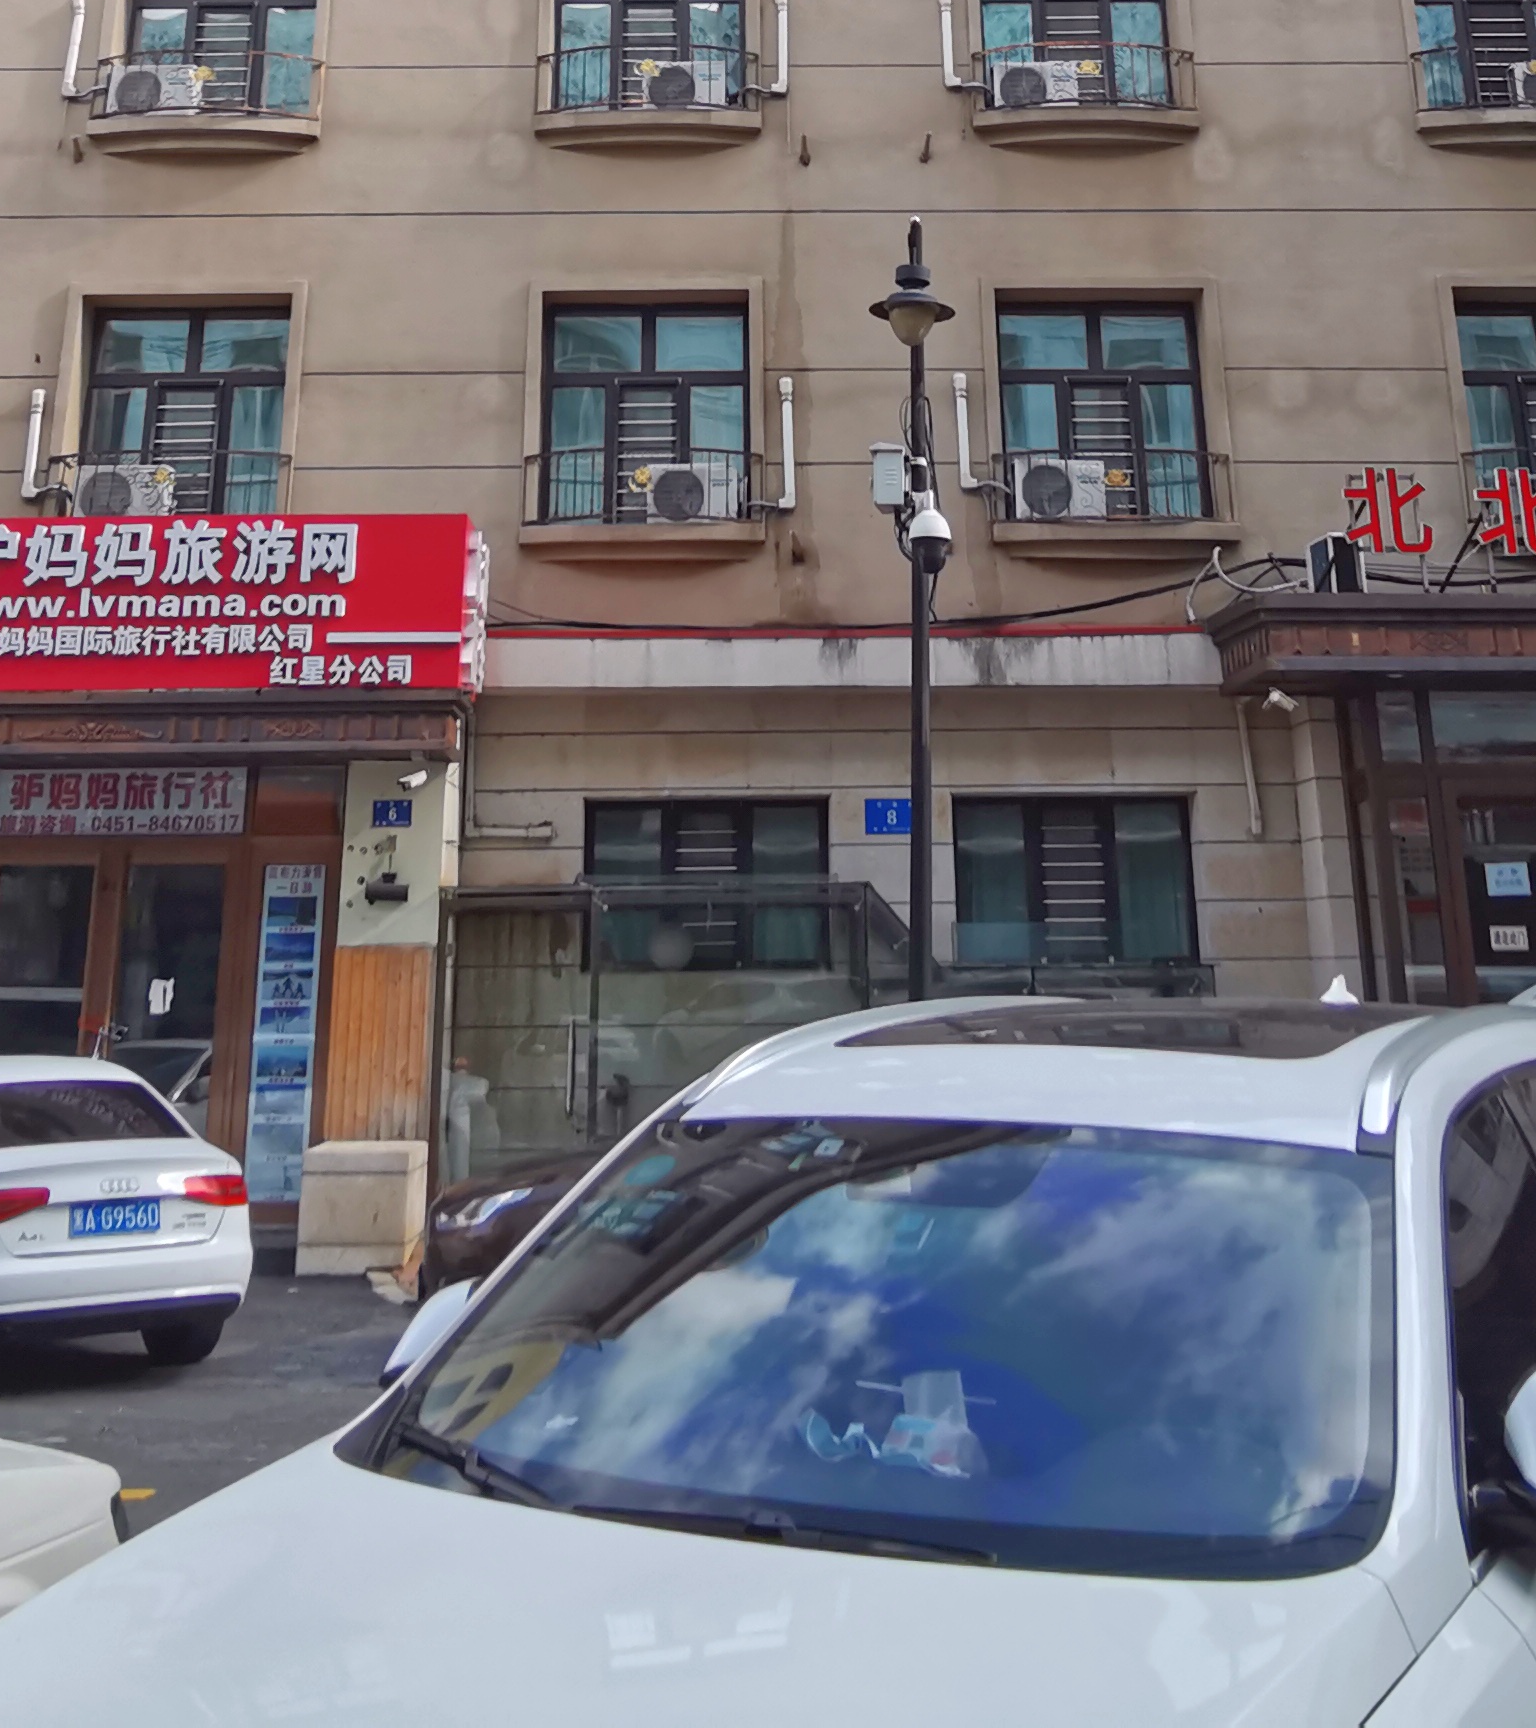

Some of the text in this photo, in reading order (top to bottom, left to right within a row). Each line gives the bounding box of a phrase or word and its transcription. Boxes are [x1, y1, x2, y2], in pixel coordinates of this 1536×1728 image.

[270, 655, 412, 686] 红星分公司
[10, 771, 234, 811] 驴妈妈旅行社
[388, 807, 397, 821] 6
[886, 809, 897, 825] 8
